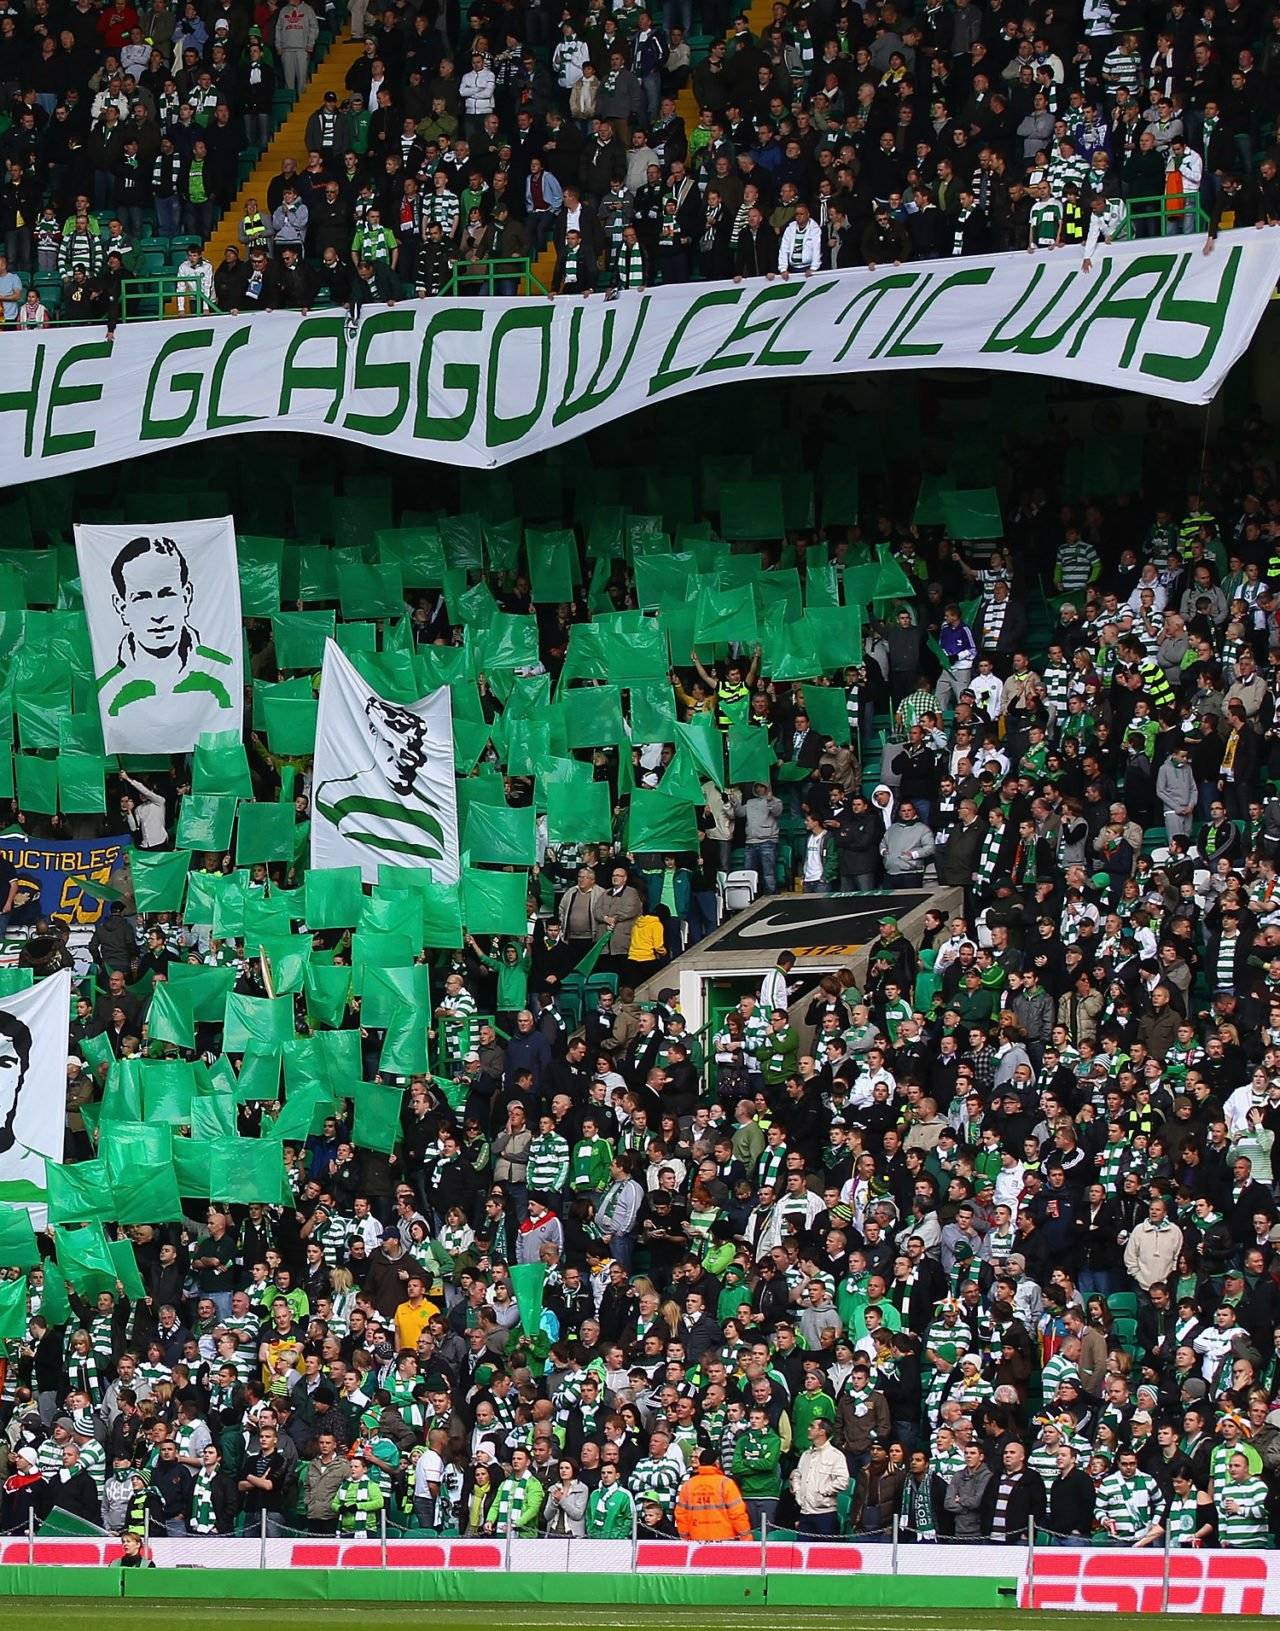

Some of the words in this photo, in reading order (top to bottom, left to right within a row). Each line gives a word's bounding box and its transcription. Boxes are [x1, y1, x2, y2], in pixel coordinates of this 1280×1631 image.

[139, 295, 650, 448] GLASGOW
[646, 267, 995, 397] CELTIC
[980, 245, 1242, 383] WAY
[801, 945, 849, 956] 112
[916, 1494, 928, 1526] BOYS
[1020, 1554, 1267, 1615] ESPN
